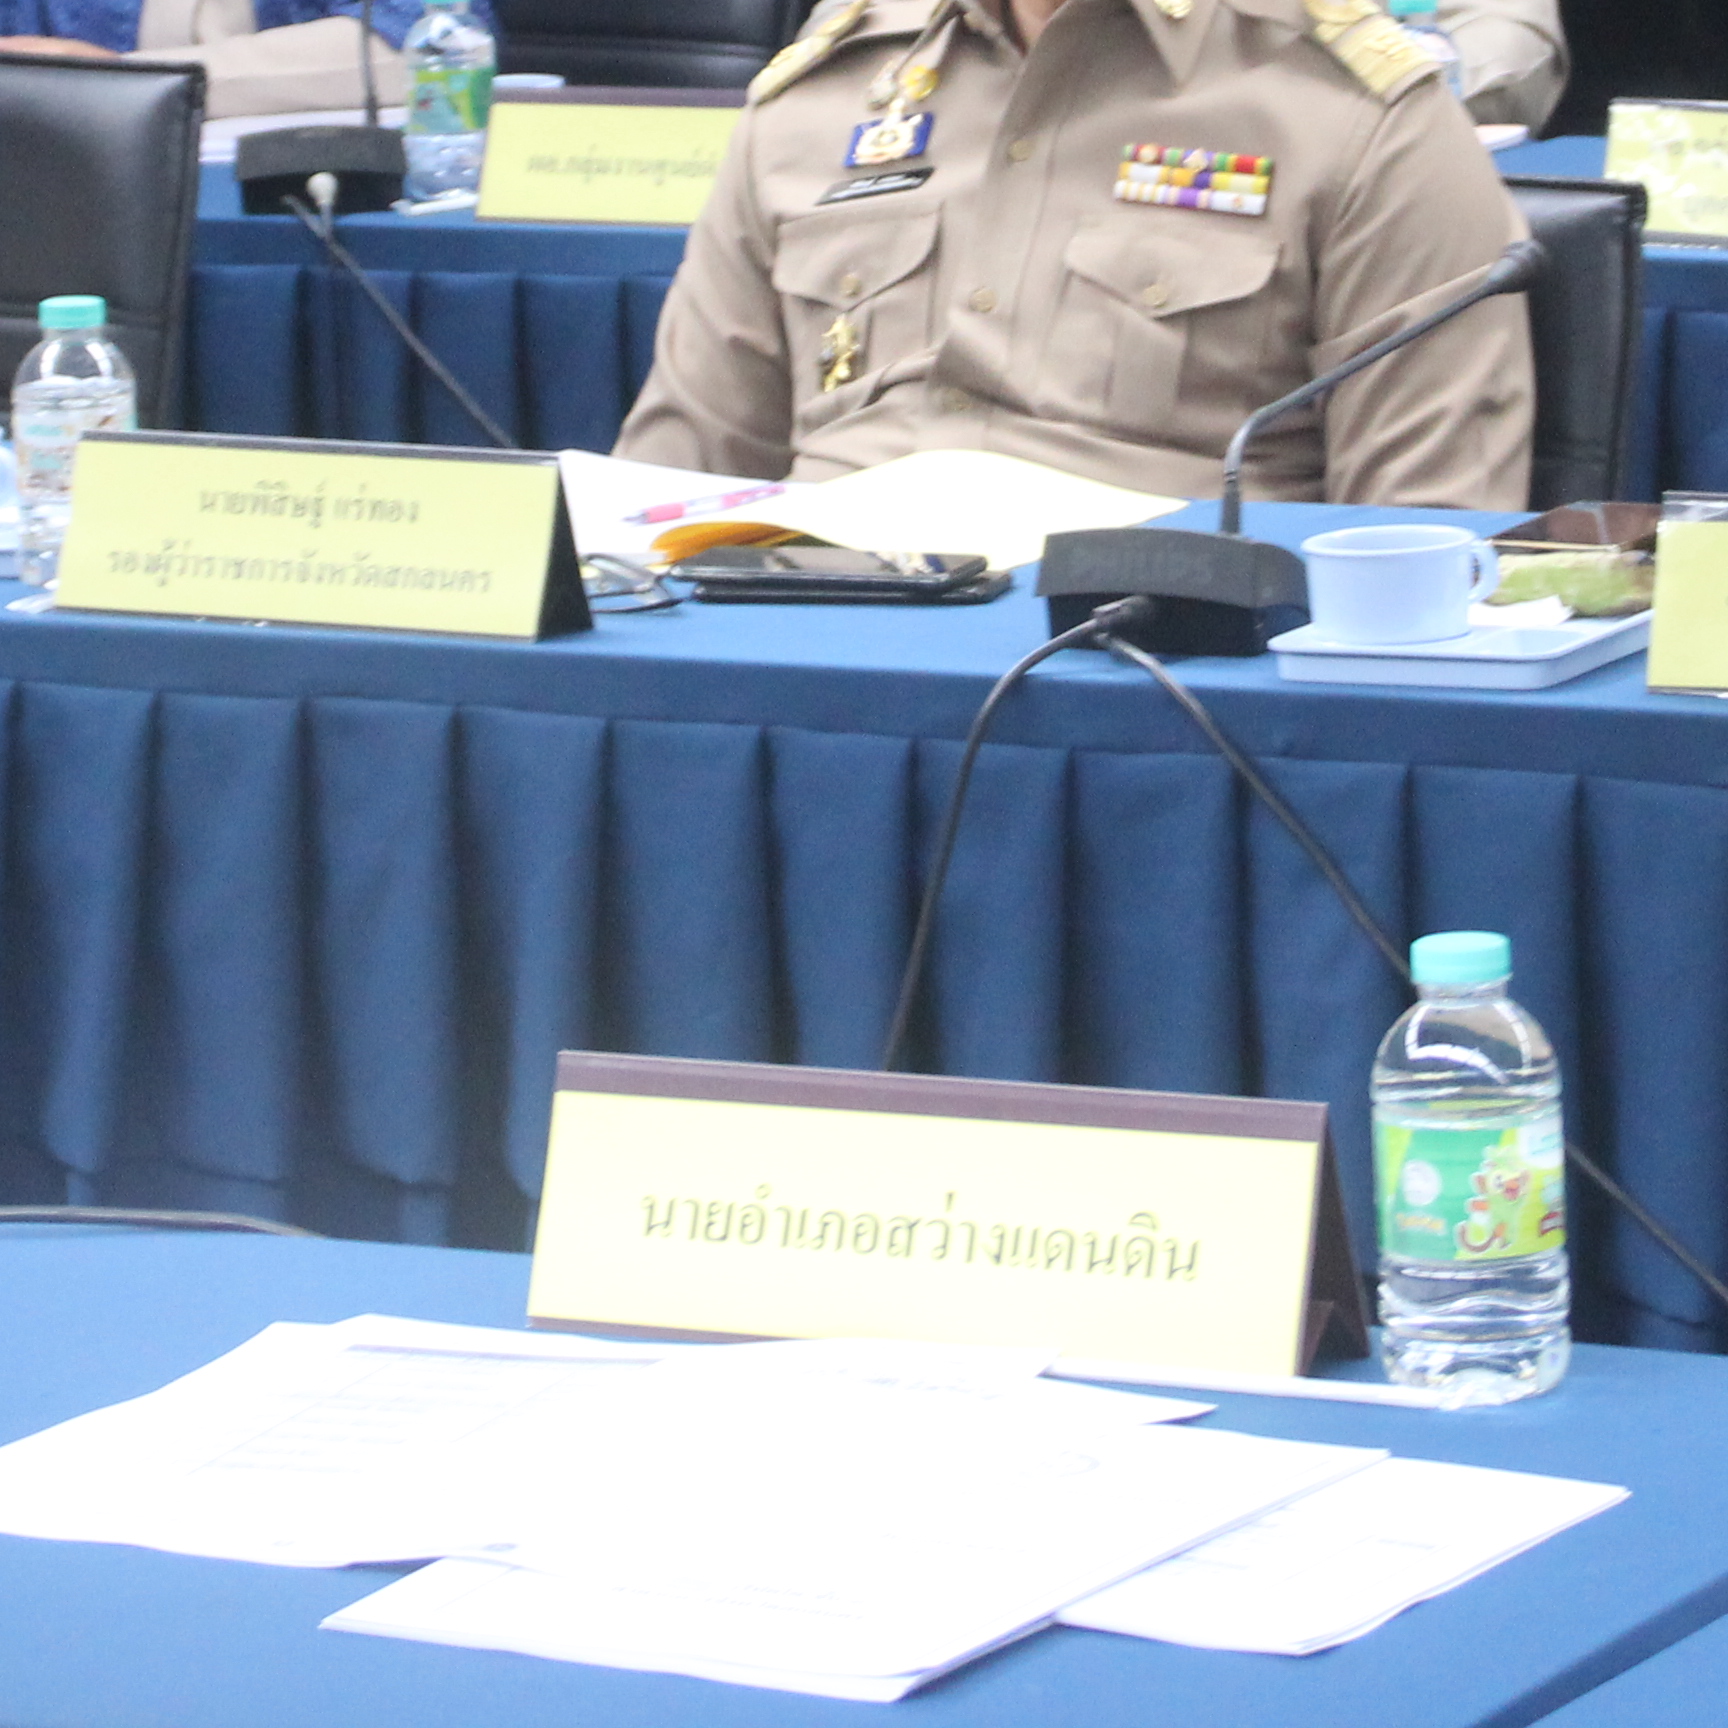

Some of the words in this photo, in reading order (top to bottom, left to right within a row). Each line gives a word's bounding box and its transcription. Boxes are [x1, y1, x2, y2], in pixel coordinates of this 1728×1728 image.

[639, 1185, 1202, 1282] นายอำเภอสว่างแดนดิน
